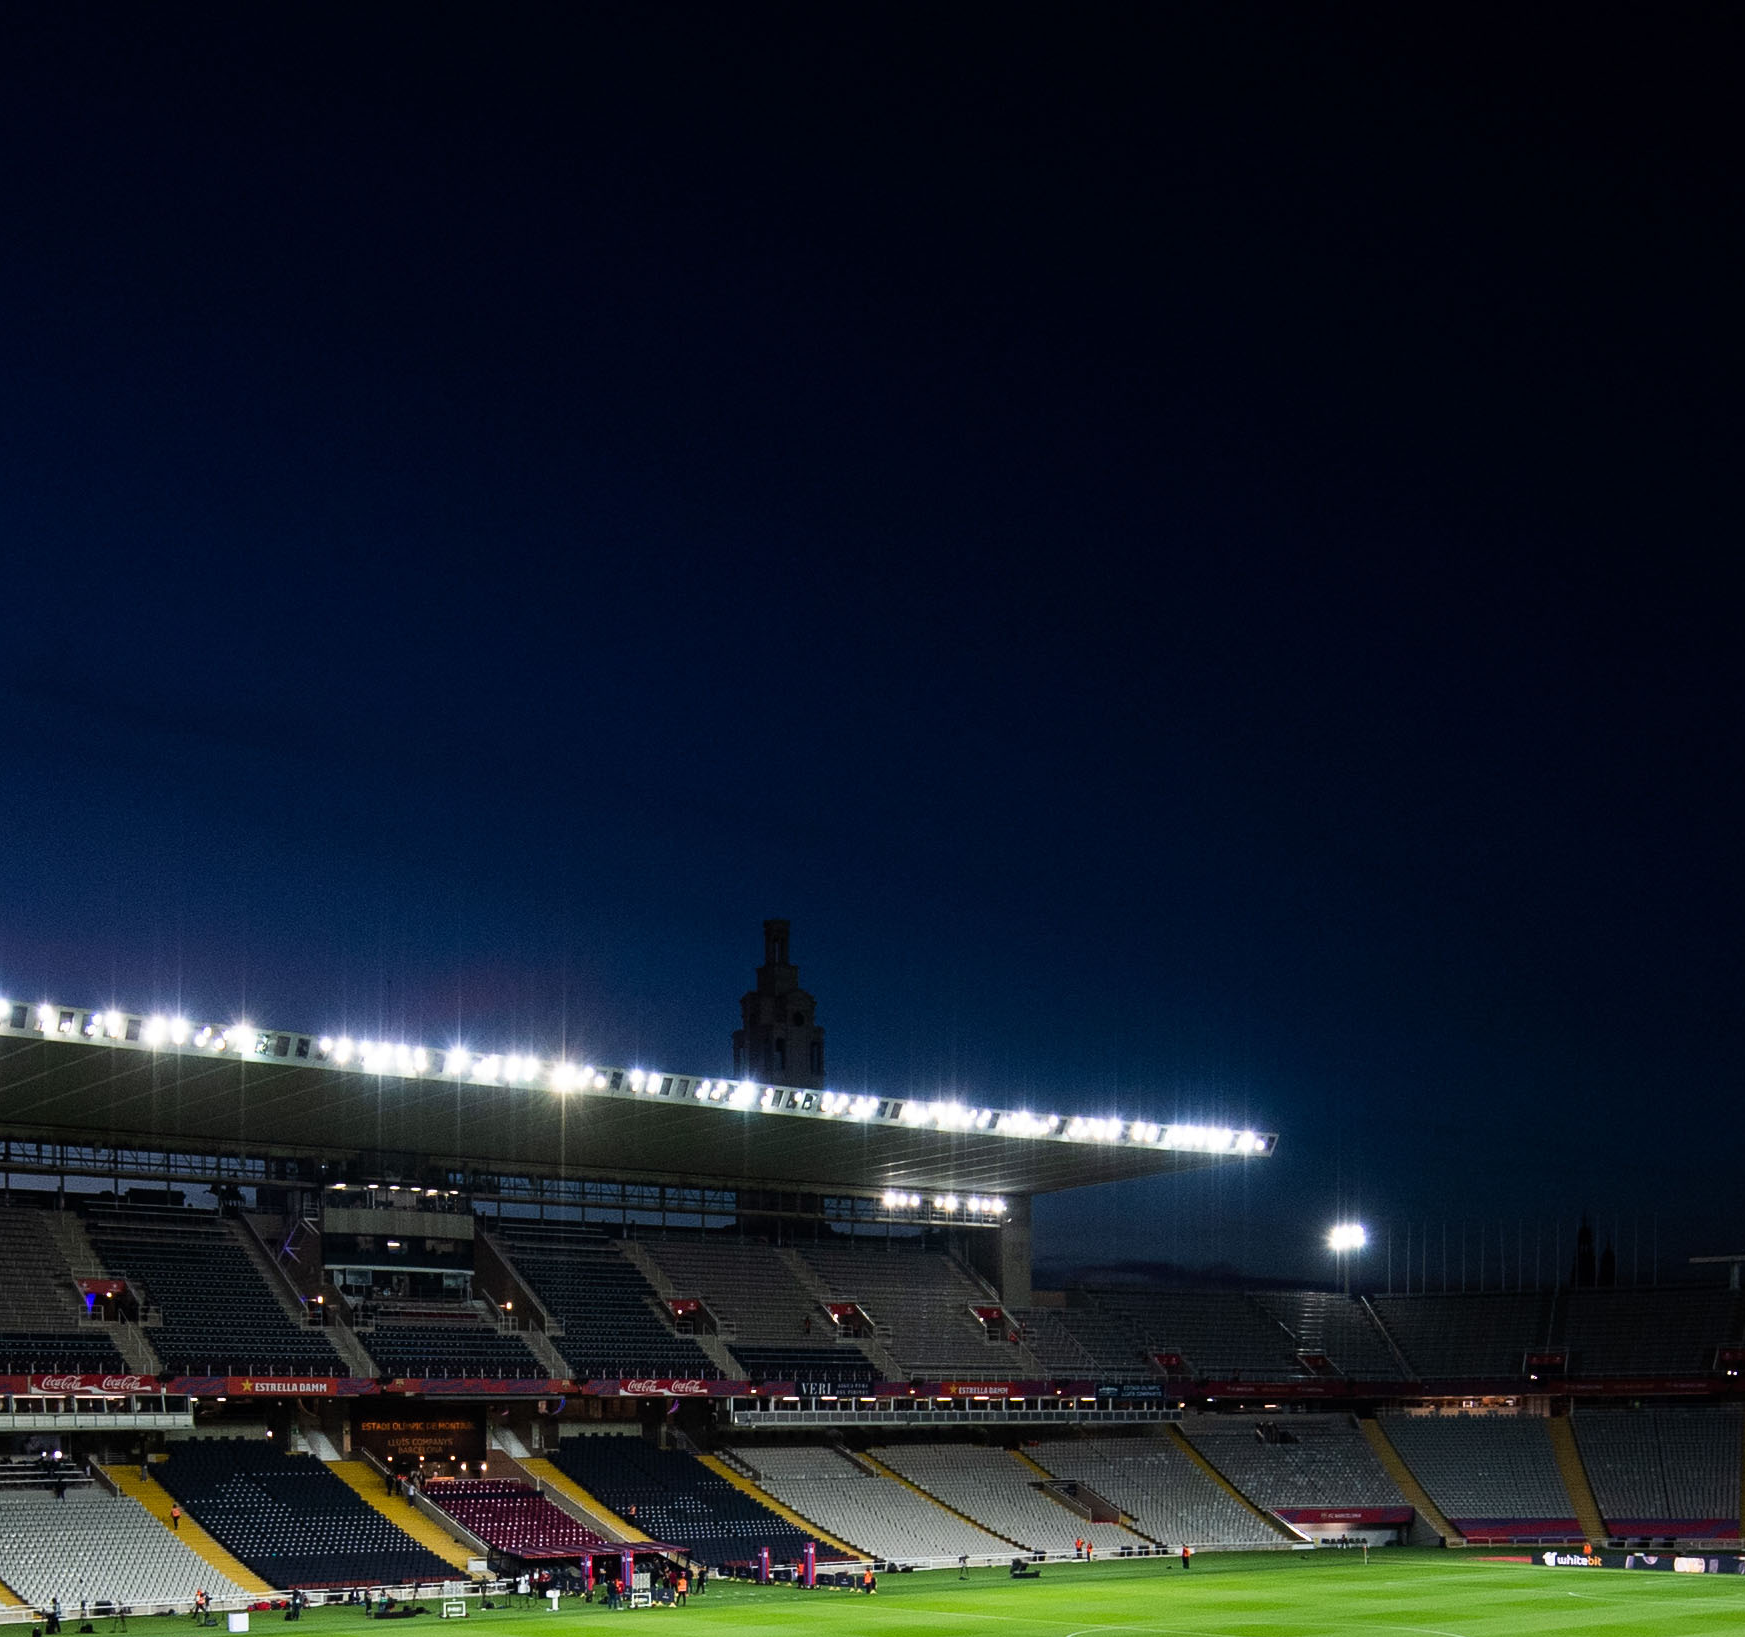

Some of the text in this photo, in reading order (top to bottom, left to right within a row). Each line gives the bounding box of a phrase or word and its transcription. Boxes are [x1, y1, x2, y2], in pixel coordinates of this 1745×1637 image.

[254, 1383, 327, 1393] ESTRELLA DAMM
[801, 1383, 831, 1395] VERI
[958, 1387, 1009, 1395] ESTRELLA DAMM
[361, 1421, 391, 1431] ESTADI
[426, 1422, 437, 1431] DE
[412, 1438, 454, 1447] COMPANYS
[398, 1446, 444, 1455] BARCELONA
[1557, 1554, 1602, 1566] whitebit
